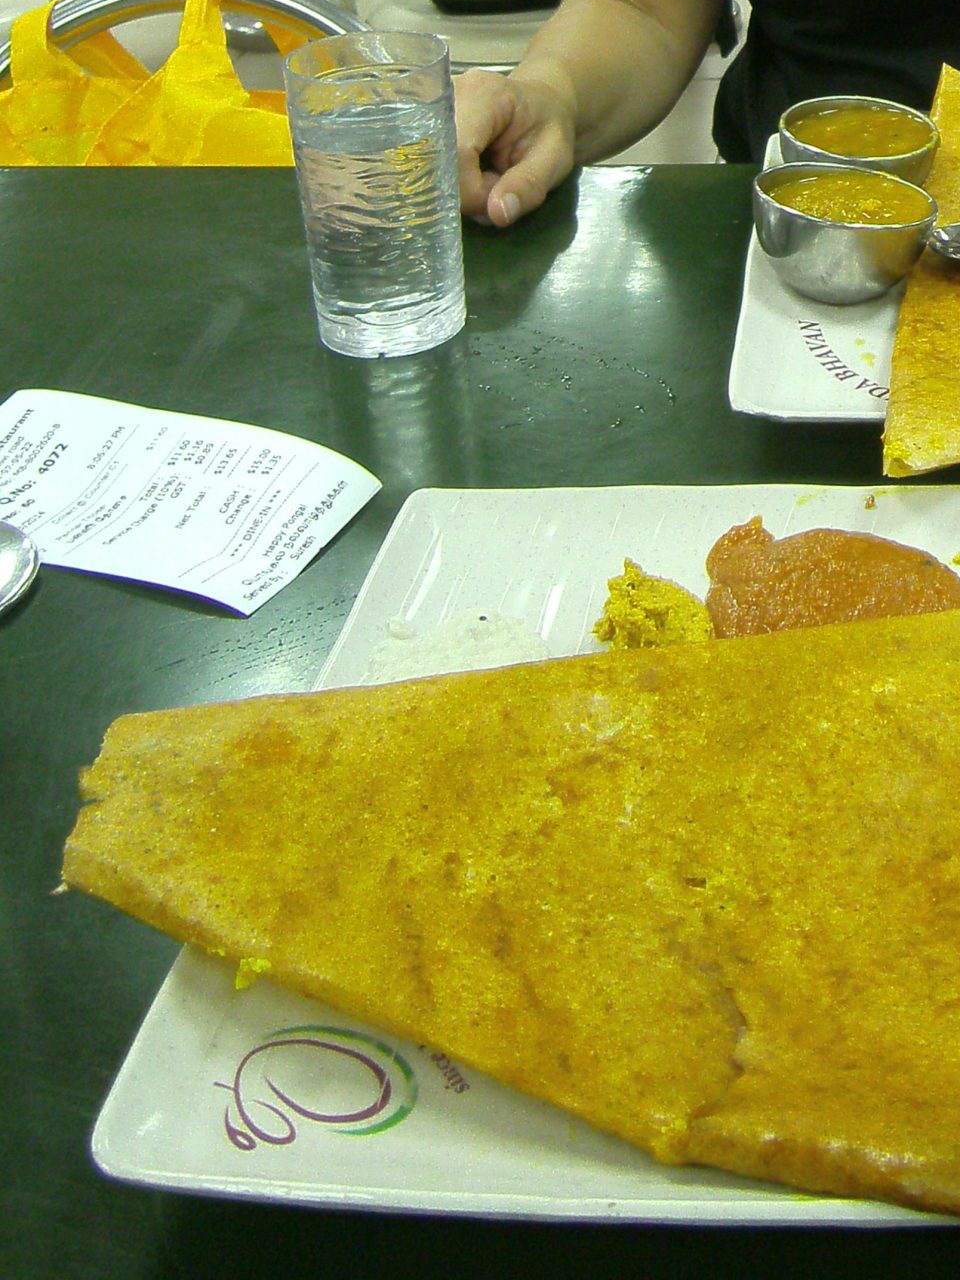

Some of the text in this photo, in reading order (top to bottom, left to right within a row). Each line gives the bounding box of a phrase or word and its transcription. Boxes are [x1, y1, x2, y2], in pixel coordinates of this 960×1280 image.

[798, 319, 861, 382] BHAVAN
[37, 442, 70, 475] 4072
[170, 480, 187, 499] GST
[219, 489, 240, 514] CASH
[225, 494, 252, 525] Change
[262, 503, 308, 558] Happy Pongal
[290, 534, 317, 561] Suresh
